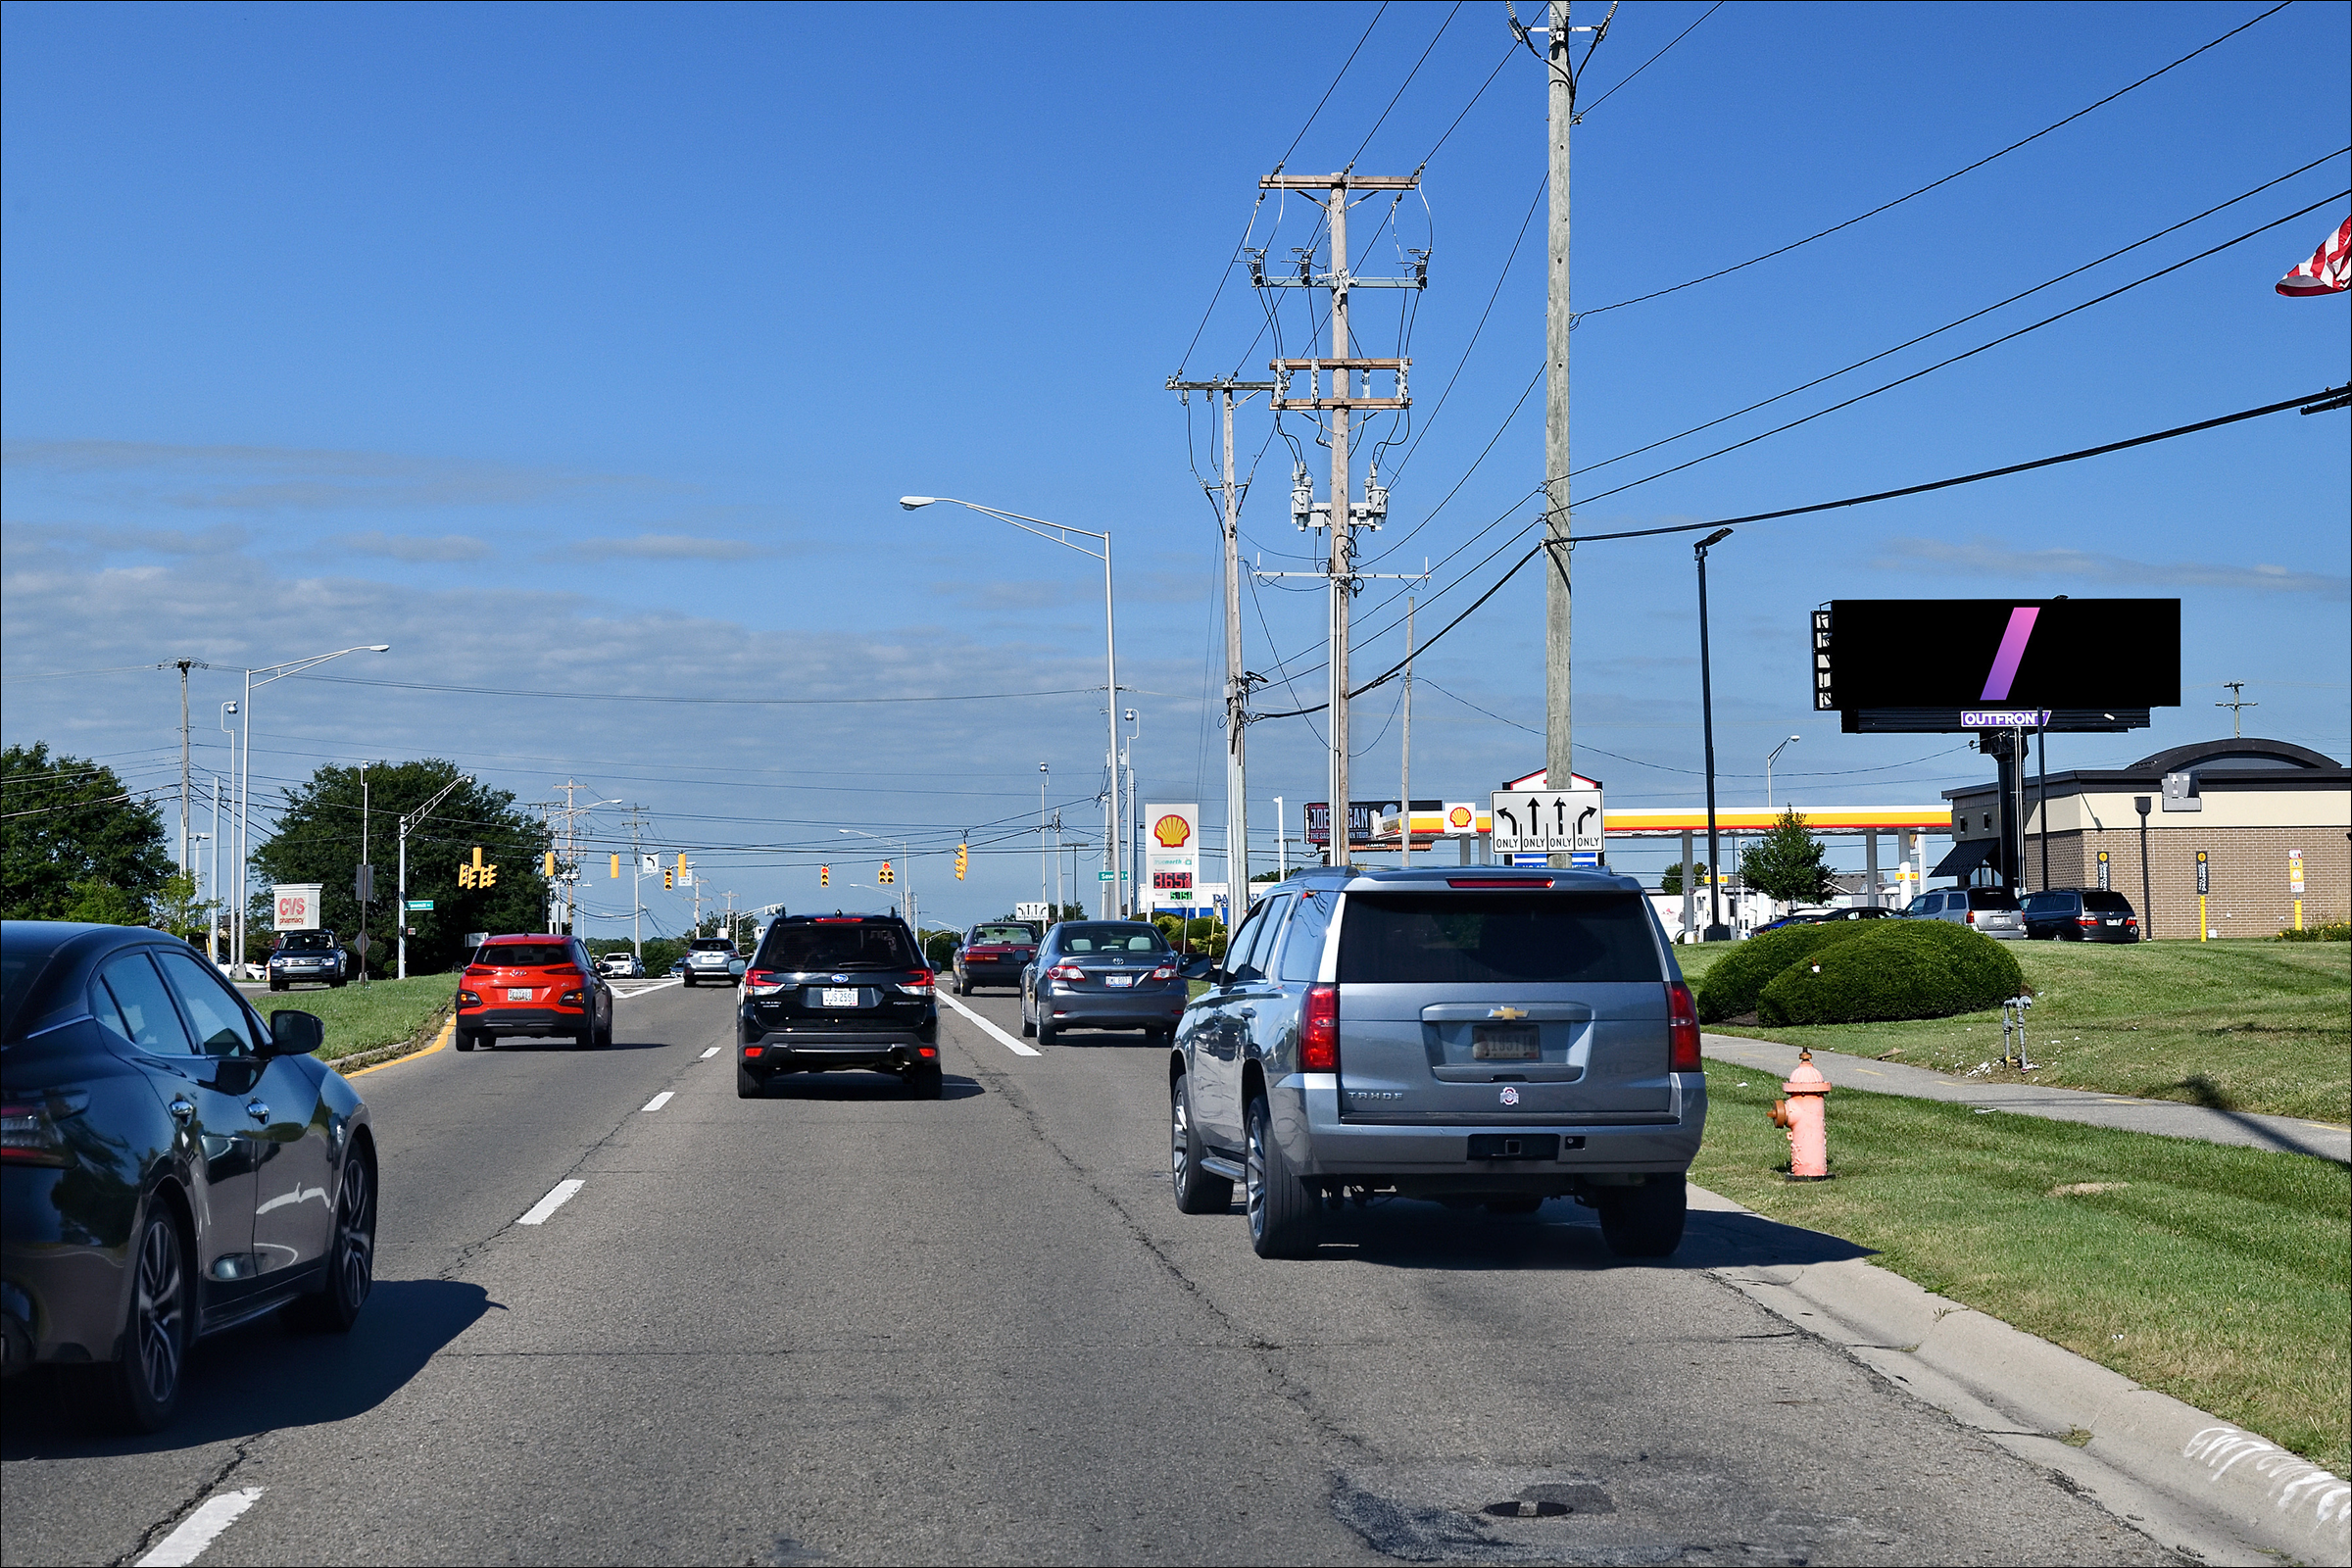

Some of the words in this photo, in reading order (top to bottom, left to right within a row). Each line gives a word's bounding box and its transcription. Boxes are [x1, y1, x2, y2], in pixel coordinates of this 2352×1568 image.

[1495, 838, 1518, 848] ONLY
[1523, 838, 1545, 848] ONLY
[1549, 838, 1572, 848] ONLY
[1577, 837, 1599, 847] ONLY
[278, 897, 305, 916] CVS
[1348, 1092, 1404, 1101] TAHOE
